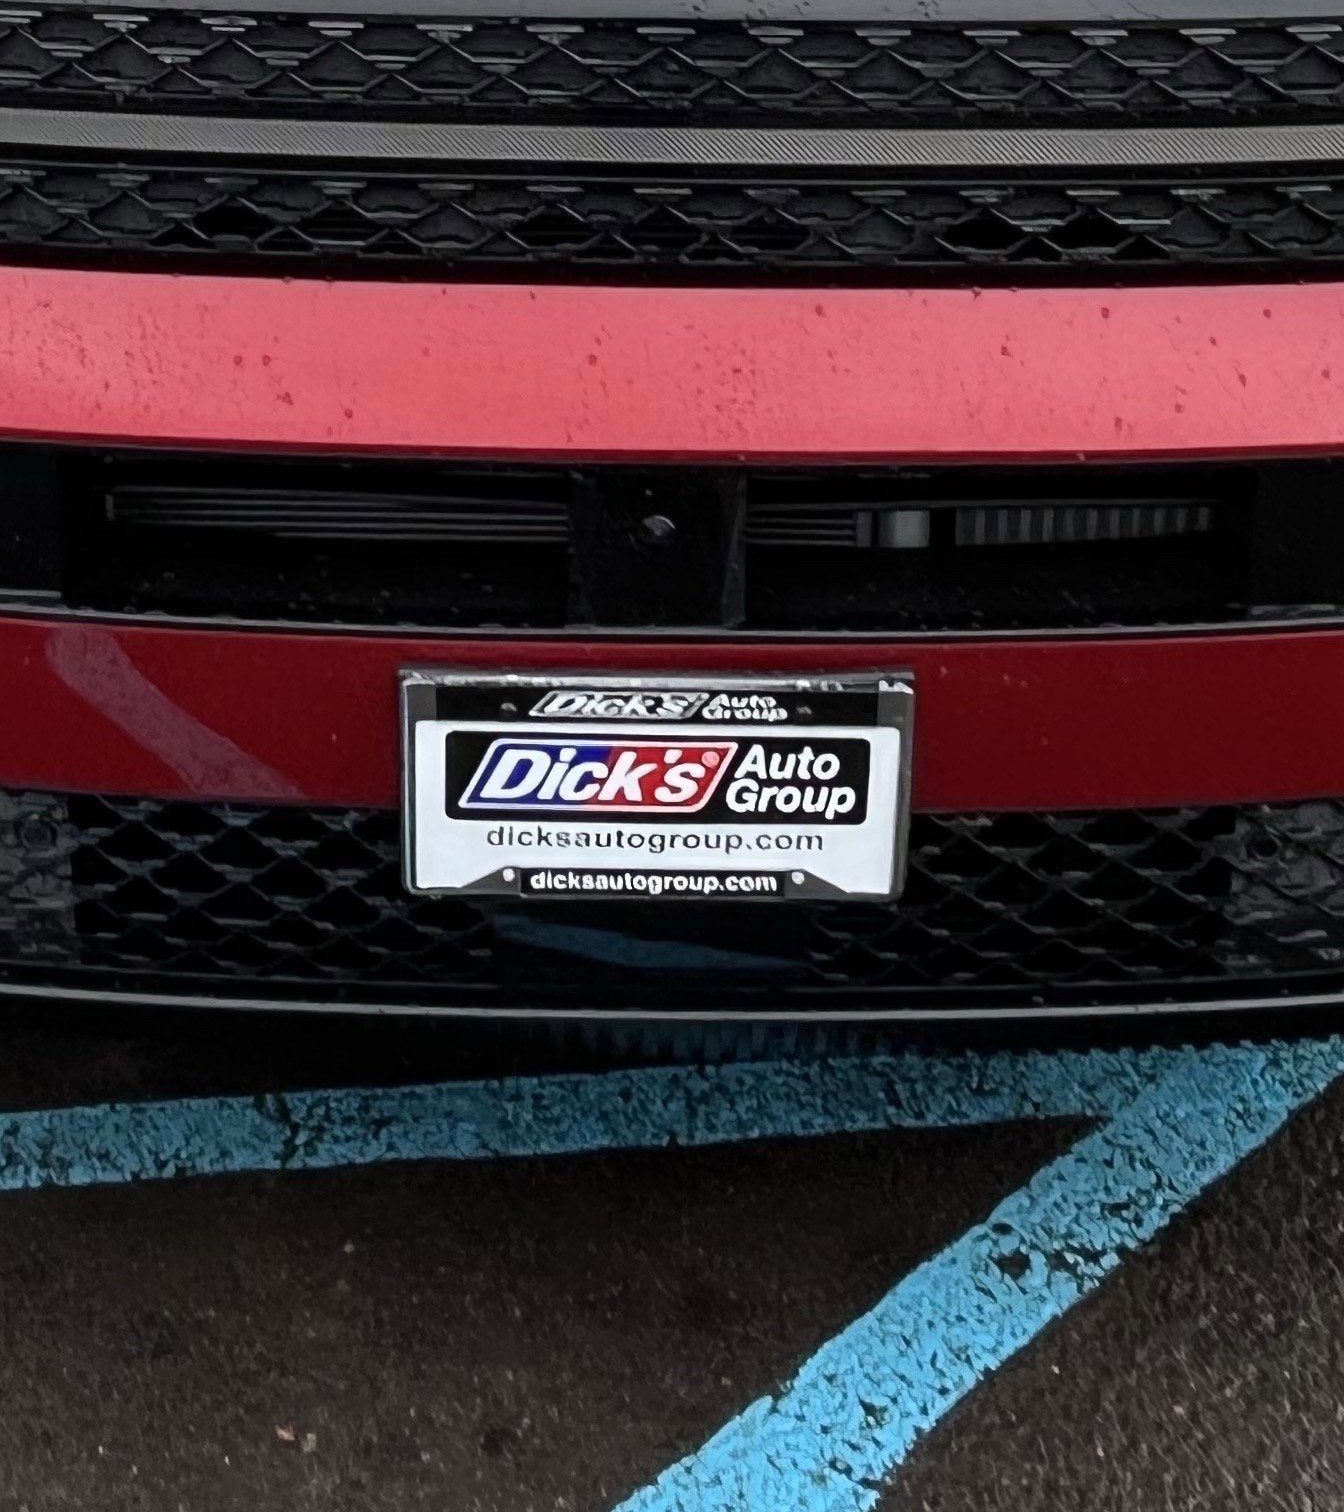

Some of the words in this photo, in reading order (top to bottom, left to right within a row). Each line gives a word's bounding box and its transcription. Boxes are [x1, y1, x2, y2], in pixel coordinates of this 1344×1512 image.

[735, 744, 840, 780] Auto
[726, 778, 856, 819] Group
[486, 826, 824, 854] dicksautogroup.com
[530, 870, 778, 895] dicksautogroup.com
